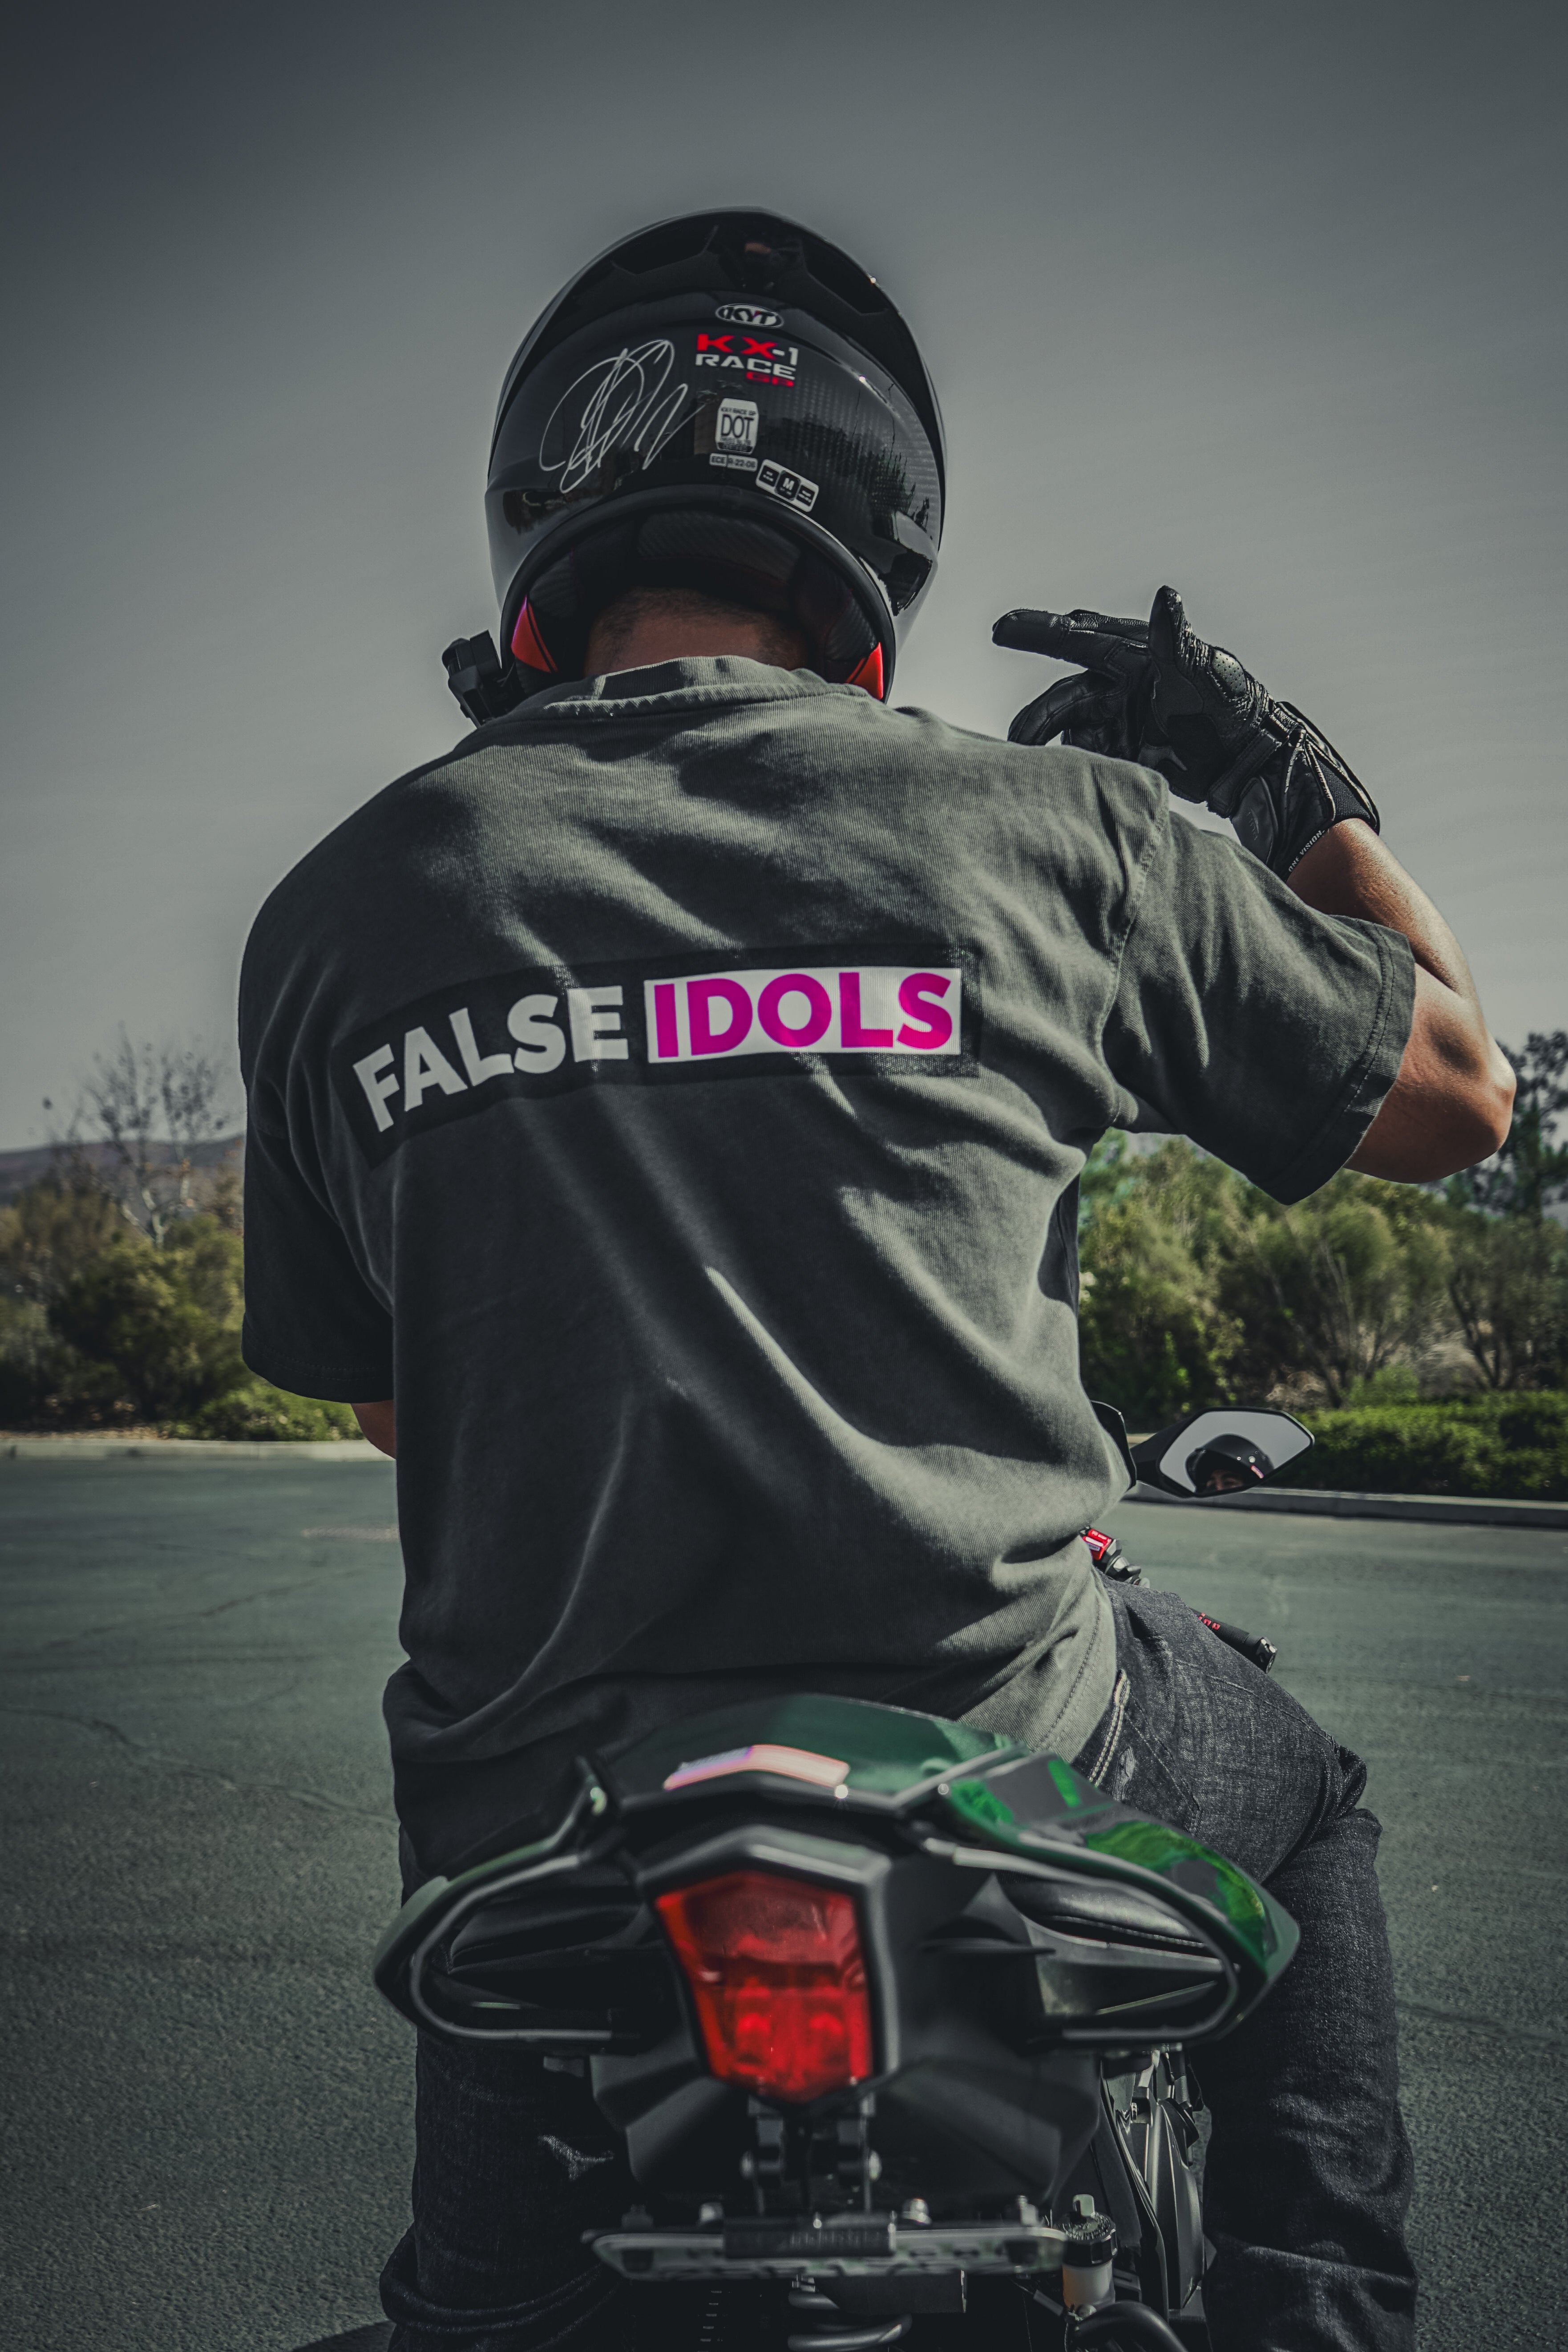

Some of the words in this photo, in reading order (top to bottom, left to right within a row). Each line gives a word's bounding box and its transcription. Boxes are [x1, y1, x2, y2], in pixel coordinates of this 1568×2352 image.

[720, 306, 779, 326] KYT
[695, 354, 796, 381] RACE
[721, 414, 754, 439] DOT
[783, 478, 795, 490] M
[1288, 856, 1300, 872] ONE
[353, 986, 629, 1132] FALSE
[654, 972, 953, 1058] IDOLS
